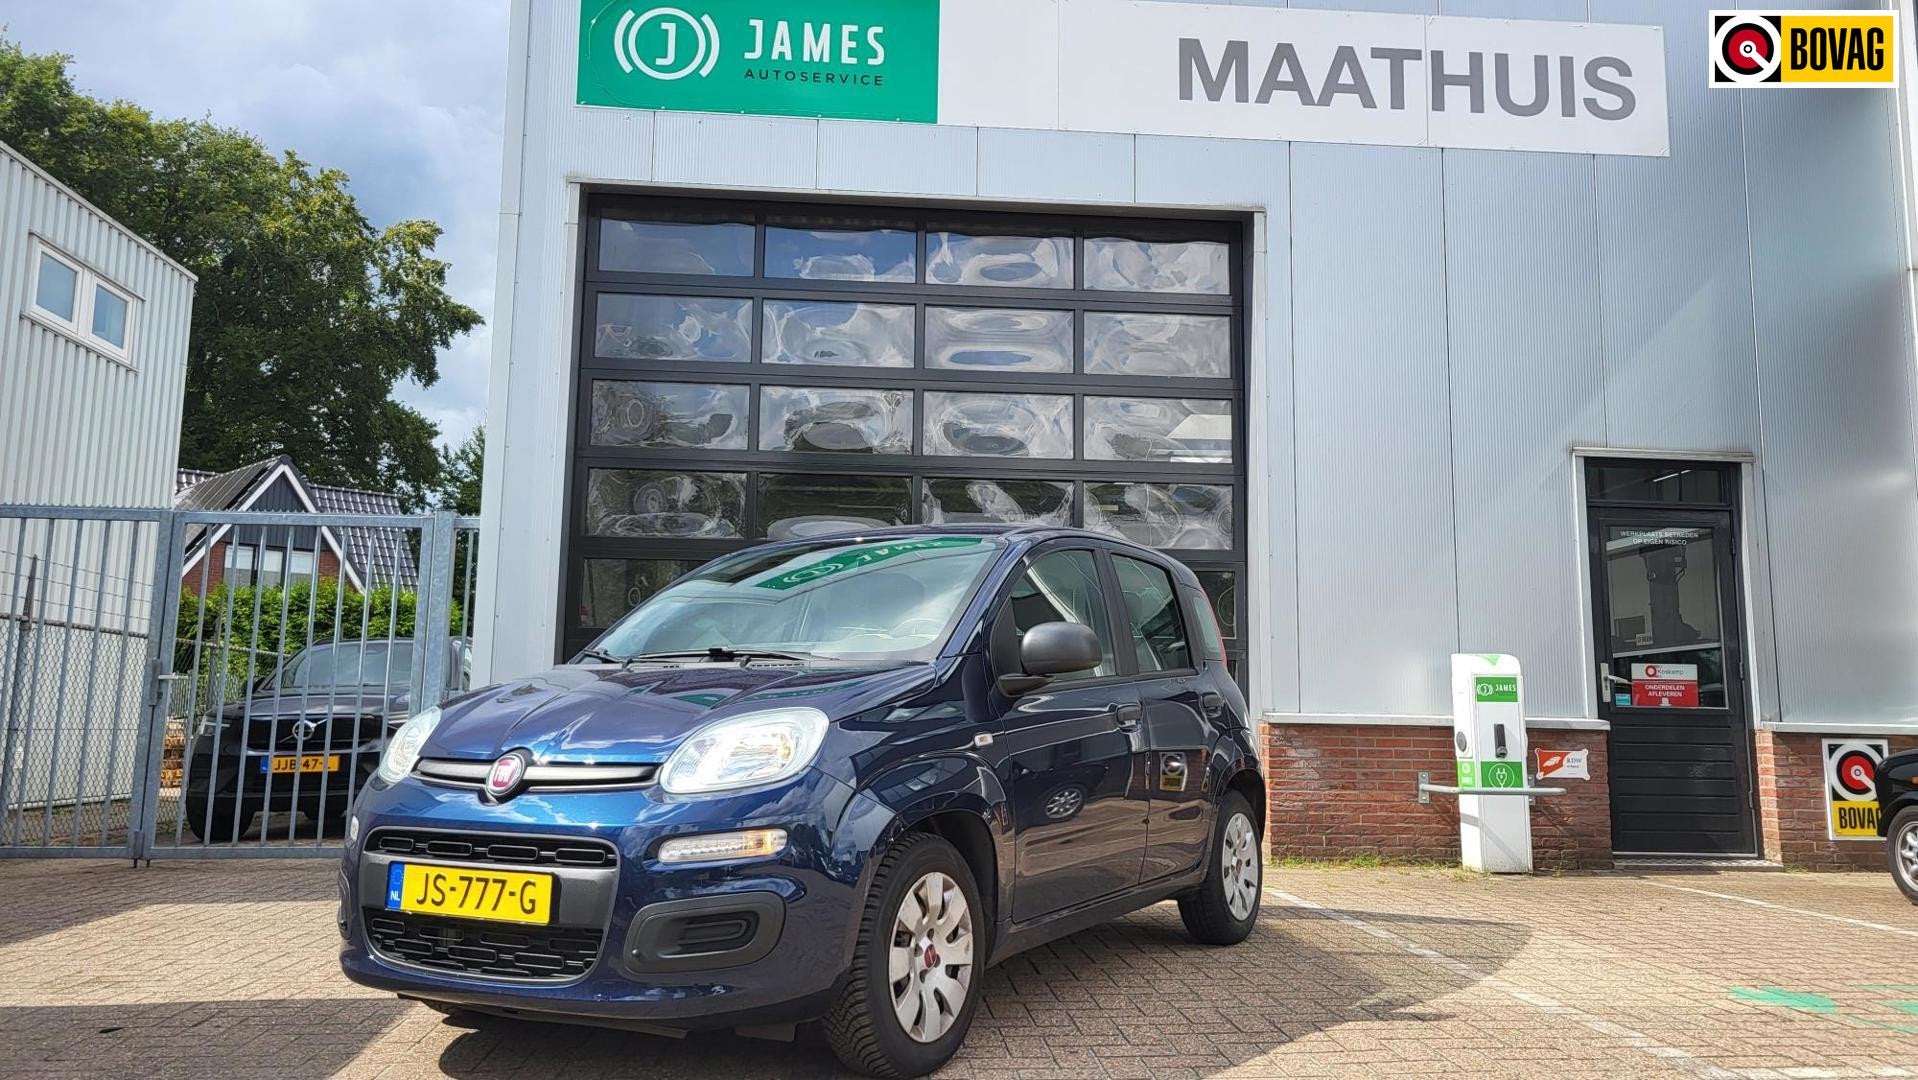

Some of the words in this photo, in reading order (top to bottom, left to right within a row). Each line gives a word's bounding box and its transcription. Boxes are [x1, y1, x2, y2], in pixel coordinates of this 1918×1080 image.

[655, 22, 676, 66] J
[744, 19, 885, 66] JAMES
[744, 69, 884, 87] AUTOSERVICE
[1178, 38, 1637, 121] MAATHUIS
[1495, 683, 1517, 692] JAMES
[390, 890, 401, 902] NL
[416, 872, 536, 915] JS-777-G
